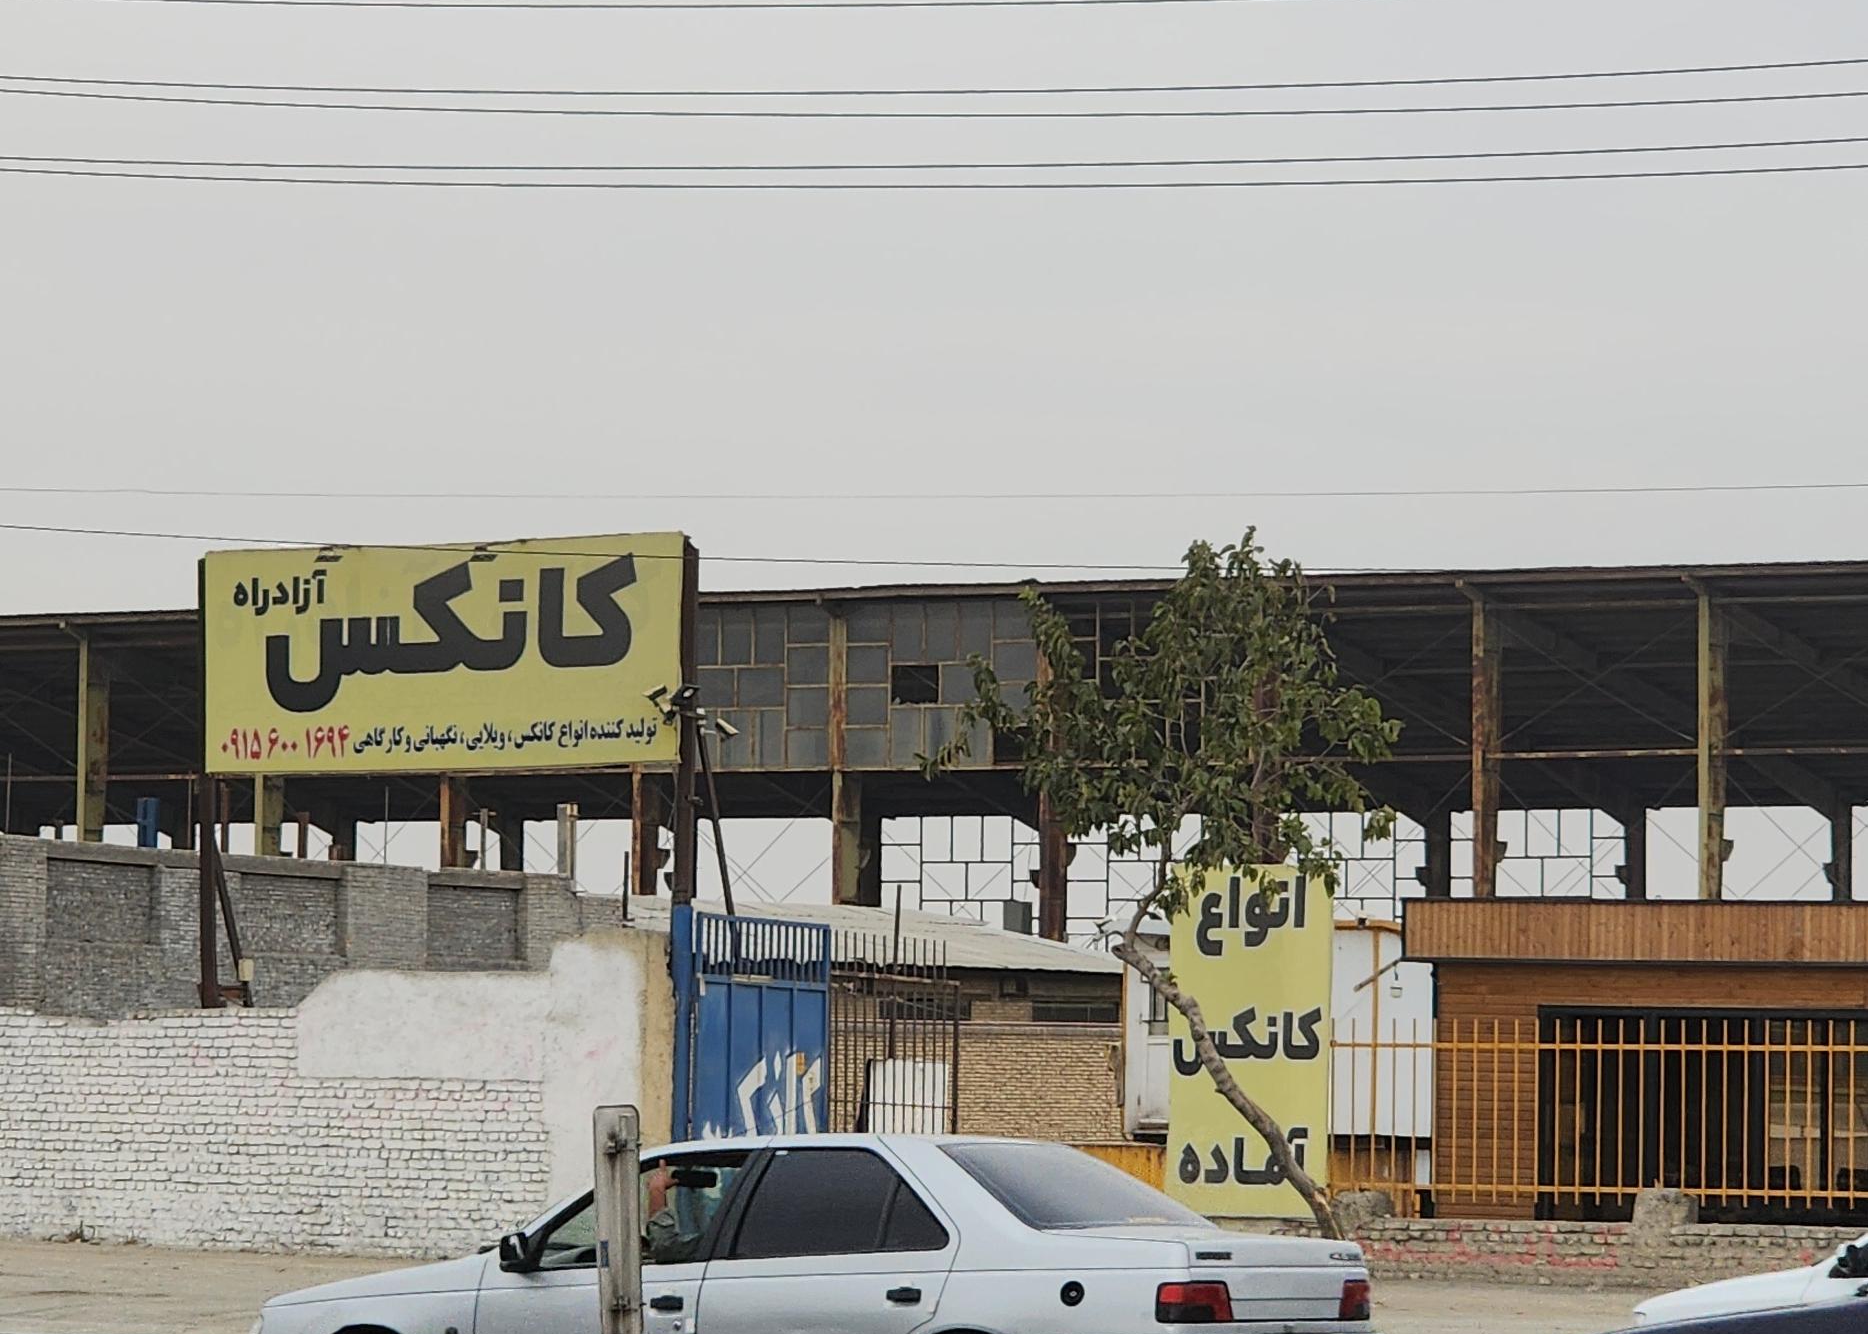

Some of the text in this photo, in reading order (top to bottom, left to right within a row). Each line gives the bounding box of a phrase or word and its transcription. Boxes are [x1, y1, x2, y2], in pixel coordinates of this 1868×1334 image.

[233, 569, 327, 617] آزادراه
[265, 552, 638, 713] کانکس
[221, 725, 350, 760] ۰۹۱۵ ۶۰۰ ۱۶۹۴
[413, 724, 458, 752] نگهبانی
[557, 719, 588, 748] انواع
[589, 718, 624, 740] کننده
[625, 717, 658, 745] تولید
[1197, 875, 1306, 956] انواع
[1173, 1007, 1322, 1076] کانکس
[1178, 1127, 1308, 1185] آماده
